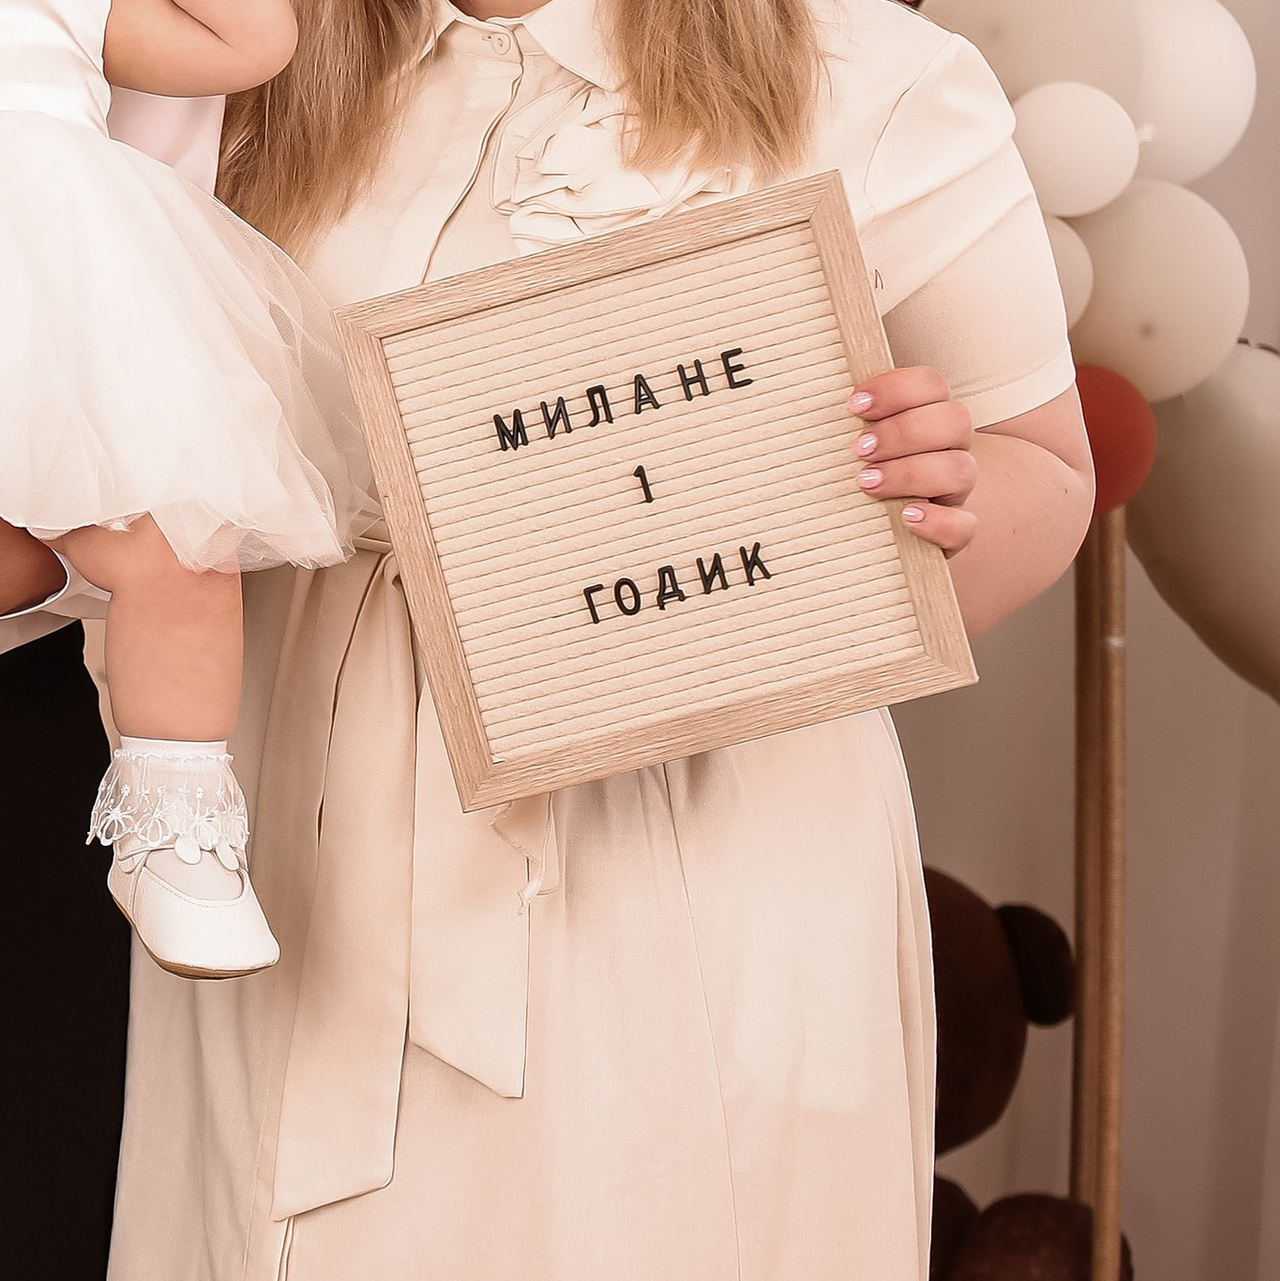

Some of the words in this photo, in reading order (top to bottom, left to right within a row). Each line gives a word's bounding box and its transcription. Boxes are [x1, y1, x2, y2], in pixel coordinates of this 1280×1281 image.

[492, 346, 754, 452] МИЛАНЕ
[632, 463, 655, 505] 1
[582, 540, 773, 625] ГОДИК
